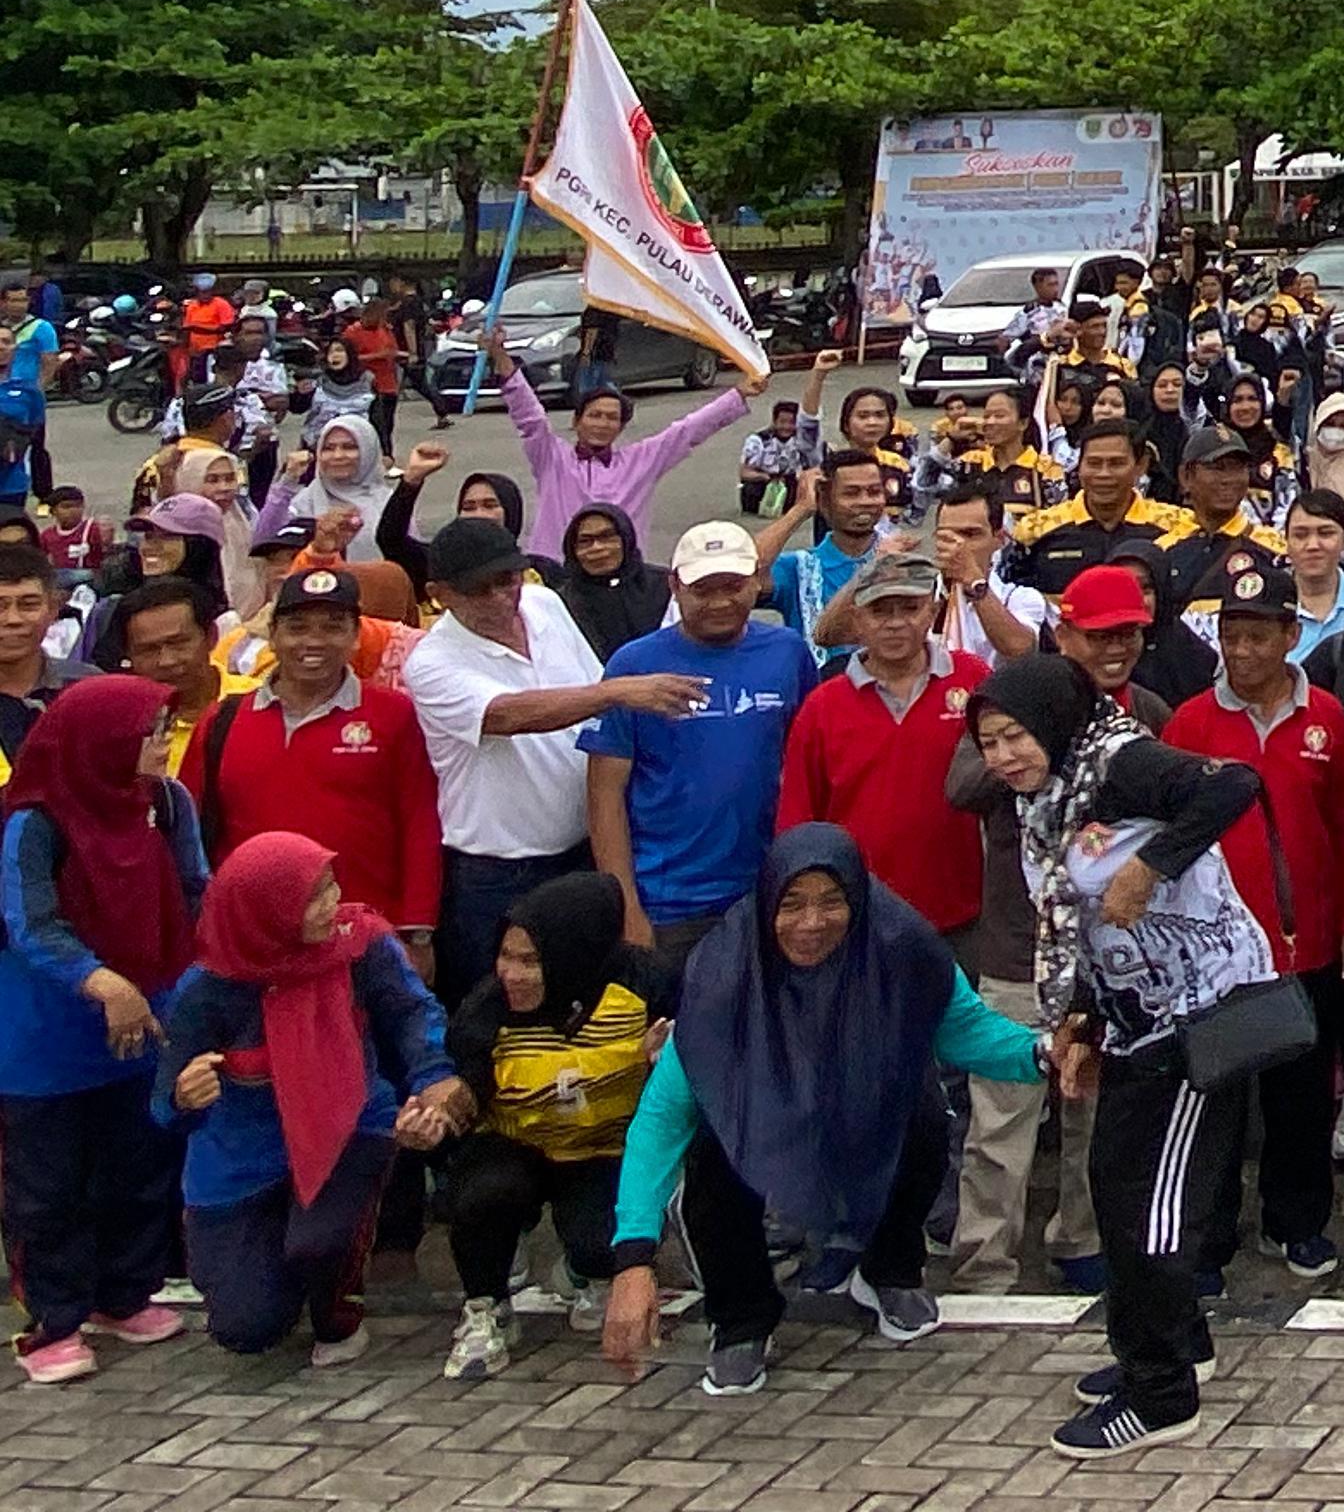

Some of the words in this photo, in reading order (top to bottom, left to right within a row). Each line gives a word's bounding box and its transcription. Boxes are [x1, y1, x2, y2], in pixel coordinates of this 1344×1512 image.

[593, 199, 631, 240] KEC.
[635, 232, 693, 284] PULAU
[695, 277, 759, 344] DERAWA
